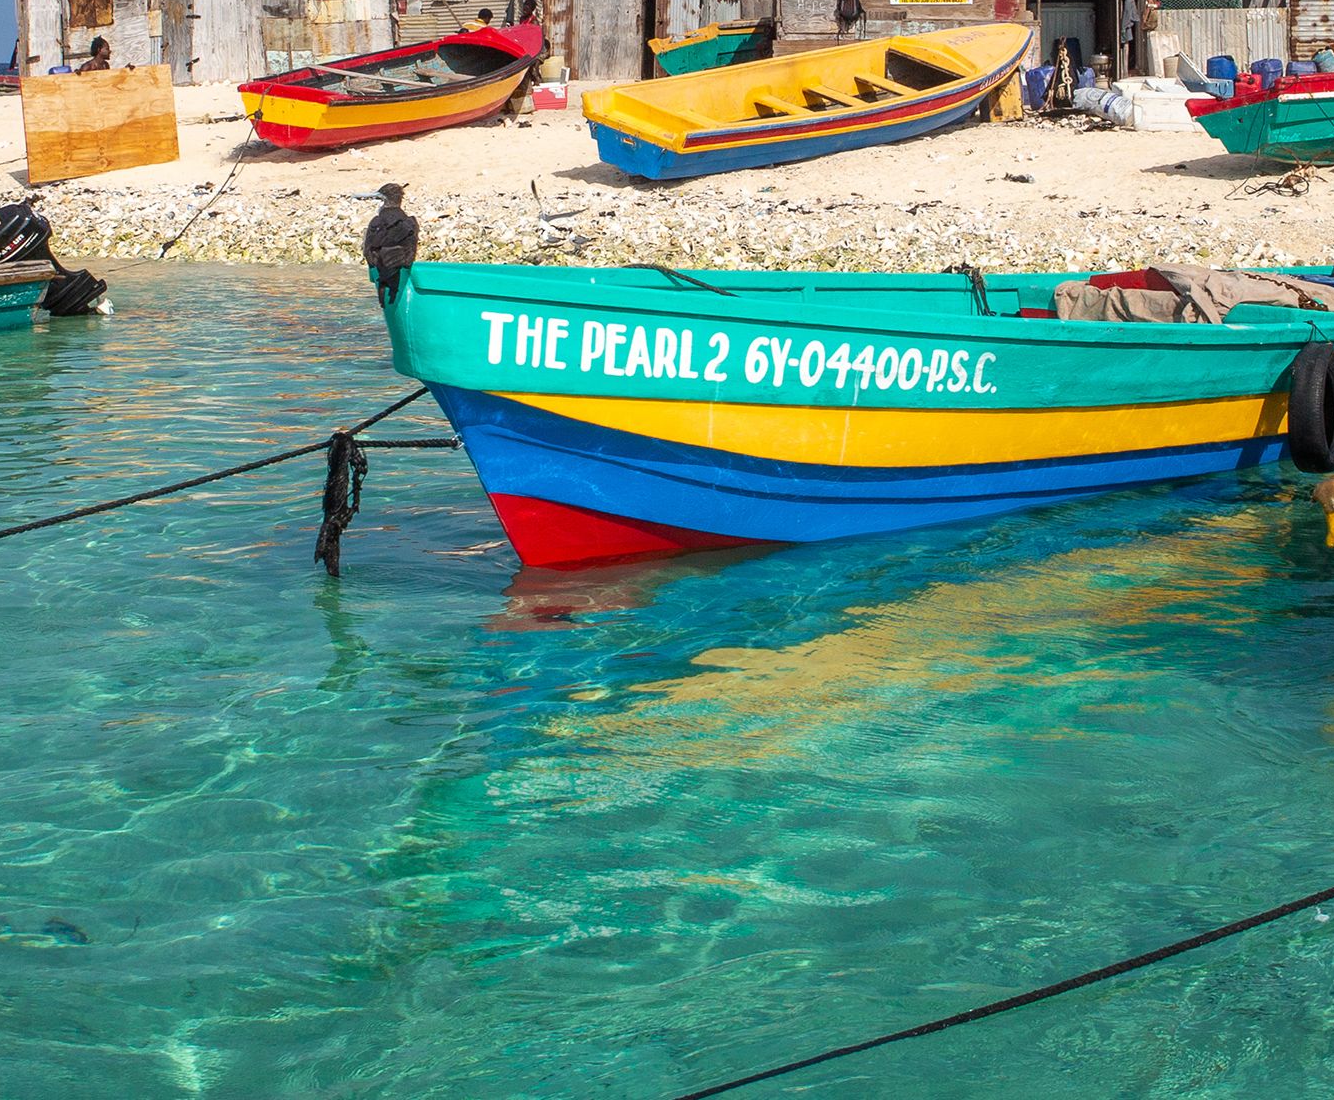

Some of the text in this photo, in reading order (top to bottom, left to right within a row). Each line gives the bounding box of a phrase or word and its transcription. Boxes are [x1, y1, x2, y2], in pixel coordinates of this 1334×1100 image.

[481, 311, 570, 370] THE
[580, 320, 699, 379] PEARL
[704, 331, 730, 382] 2
